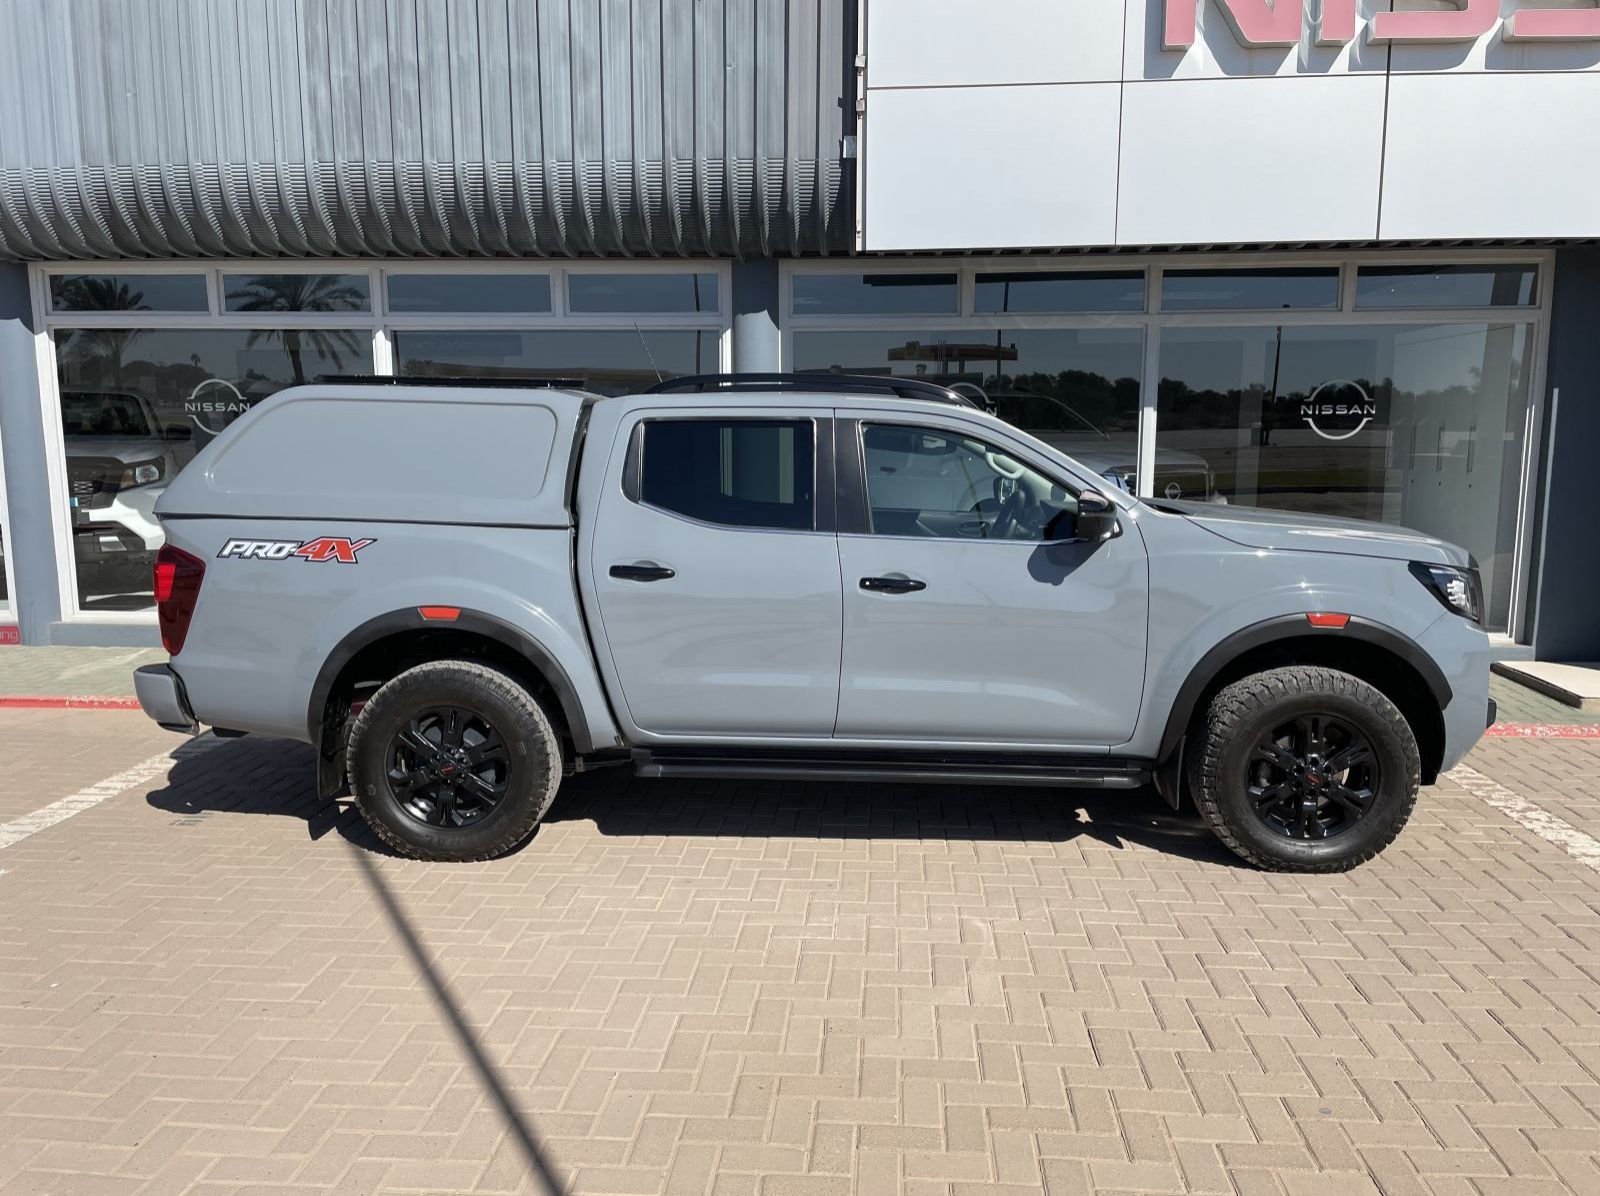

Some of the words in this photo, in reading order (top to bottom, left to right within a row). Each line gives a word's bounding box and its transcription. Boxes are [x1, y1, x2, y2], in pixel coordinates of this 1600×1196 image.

[184, 402, 250, 412] NISSAN
[1300, 404, 1376, 415] NISSAN
[216, 536, 378, 564] PRO-4X
